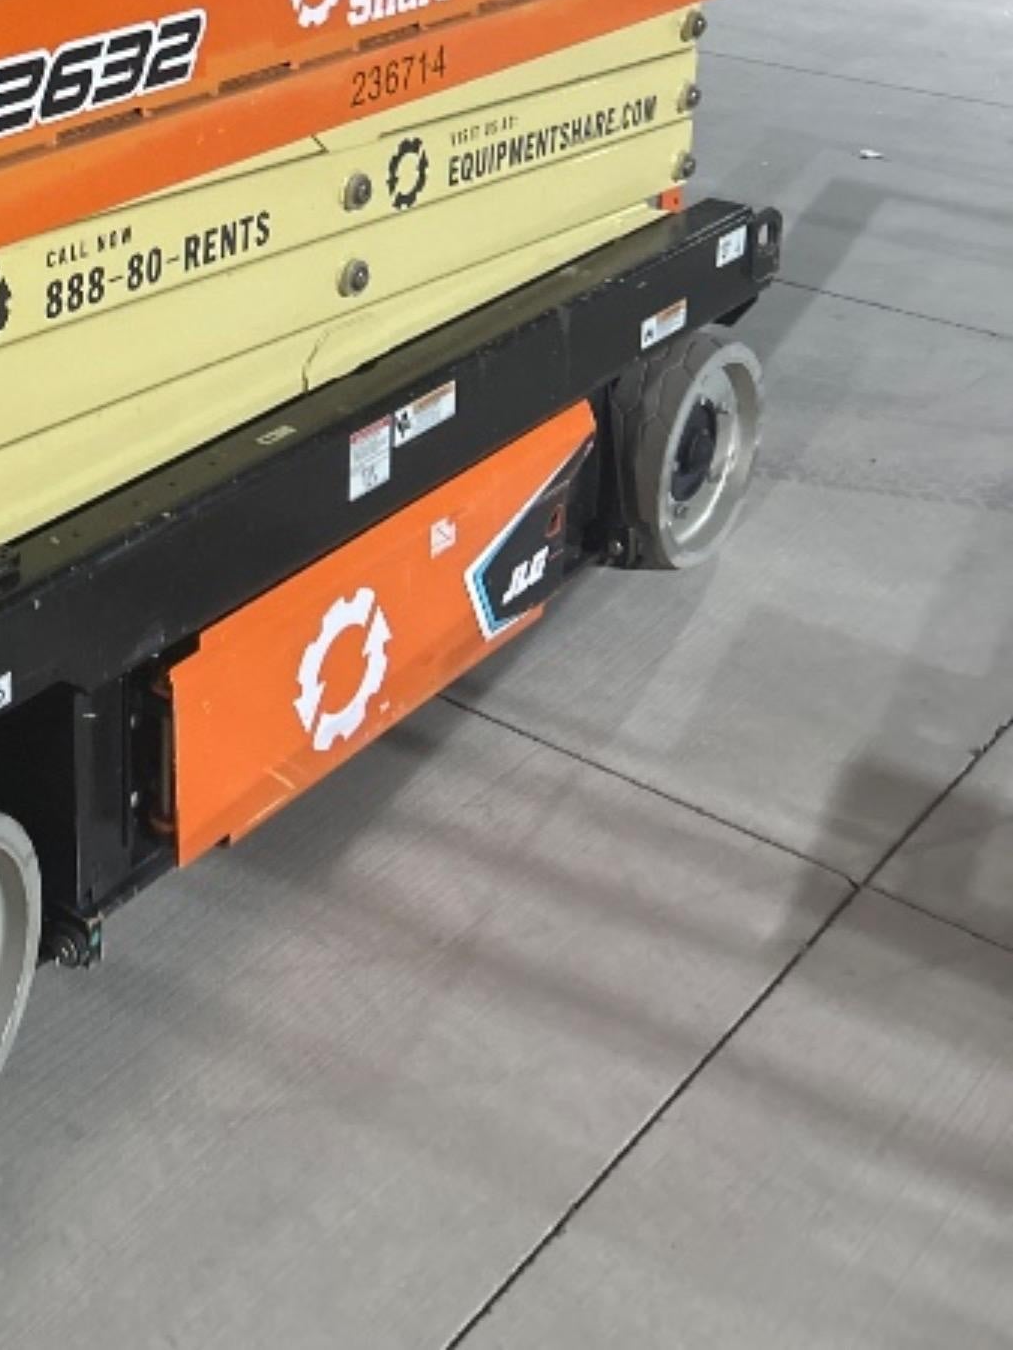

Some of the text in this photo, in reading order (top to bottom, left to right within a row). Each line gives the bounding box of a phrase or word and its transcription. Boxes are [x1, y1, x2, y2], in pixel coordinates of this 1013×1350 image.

[350, 43, 446, 108] 236714
[448, 95, 657, 187] EQUIPMENTSHARE.COM
[46, 224, 132, 268] CALL NOW
[46, 210, 270, 319] 888-80-RENTS
